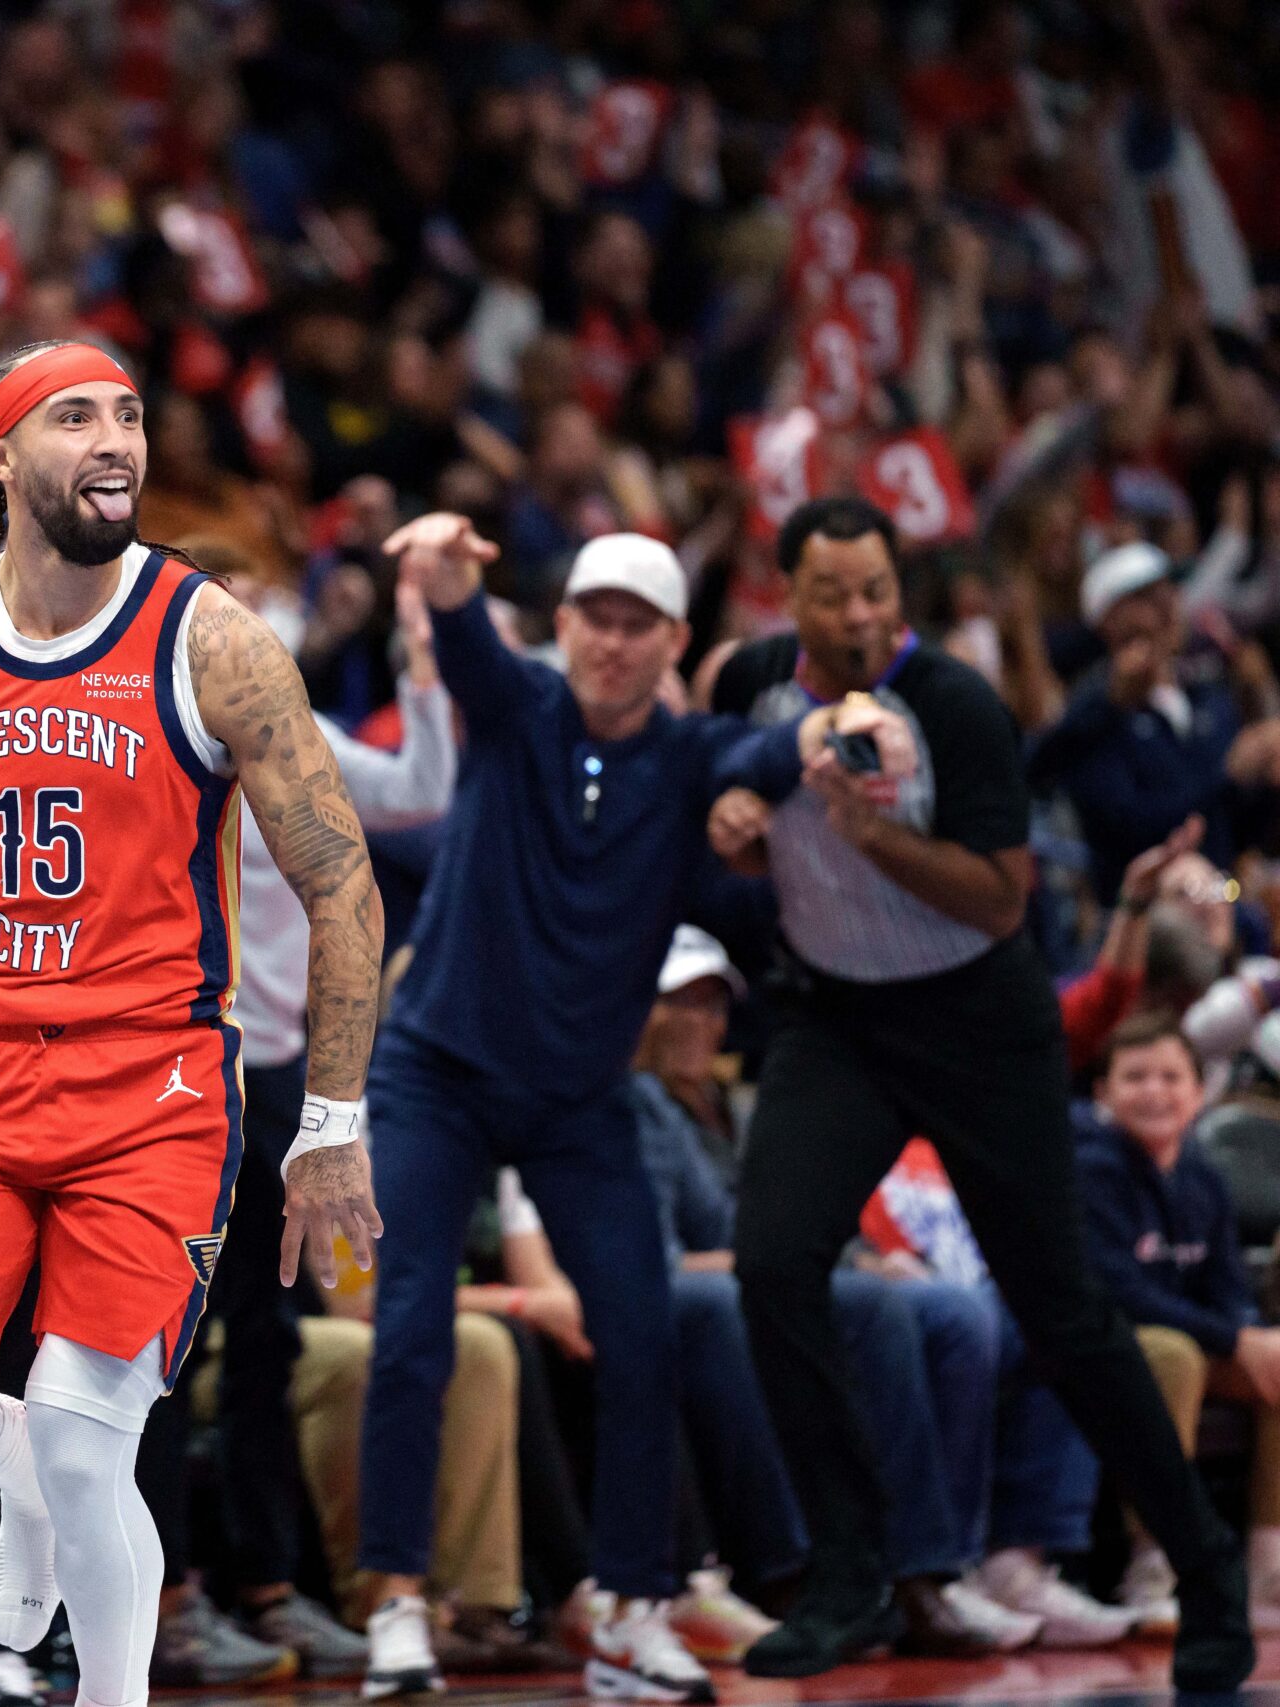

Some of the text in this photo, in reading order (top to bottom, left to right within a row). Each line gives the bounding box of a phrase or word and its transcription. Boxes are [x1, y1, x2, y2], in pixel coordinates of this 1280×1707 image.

[876, 440, 950, 537] 3
[81, 673, 151, 688] NEWAGE
[86, 690, 143, 699] PRODUCTS
